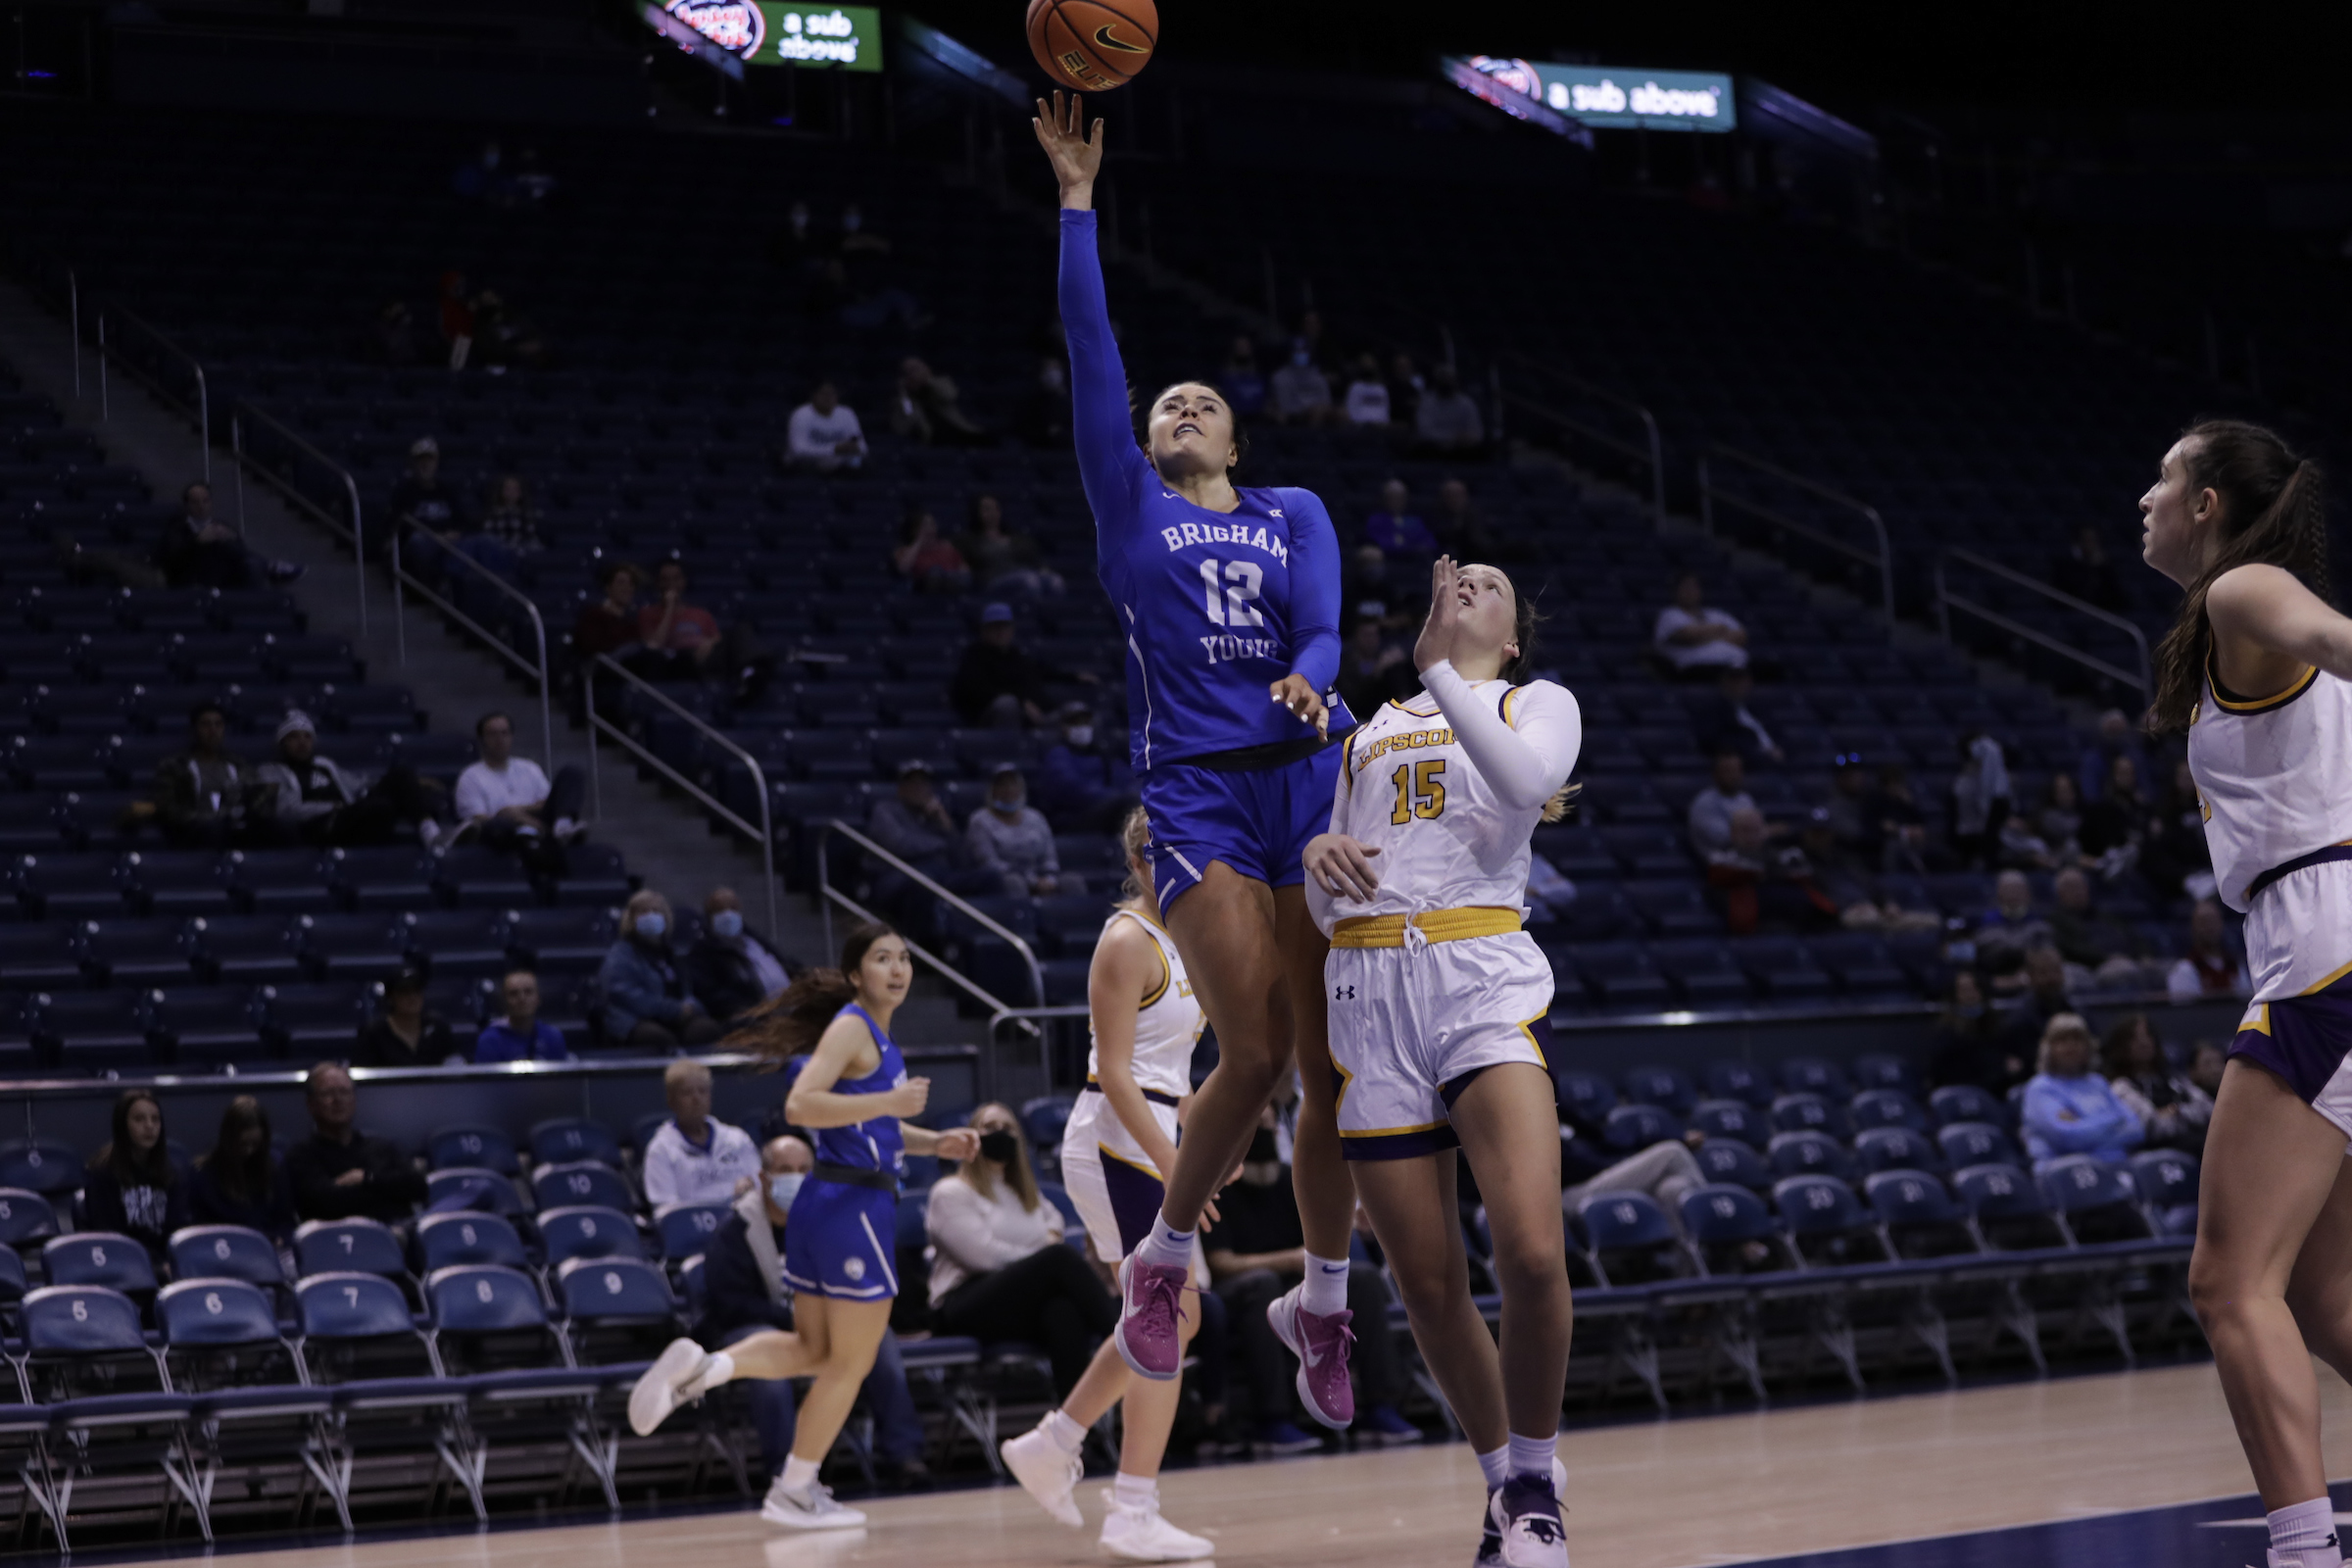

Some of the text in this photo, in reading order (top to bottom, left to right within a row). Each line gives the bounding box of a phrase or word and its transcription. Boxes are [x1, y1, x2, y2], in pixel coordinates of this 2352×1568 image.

[783, 10, 853, 37] a sub
[778, 33, 857, 63] above
[1547, 81, 1570, 110] a
[1571, 78, 1627, 113] sub
[1630, 80, 1718, 118] above
[1160, 522, 1289, 568] BRIGHAM
[1200, 558, 1264, 627] 12
[1200, 634, 1279, 664] YOUNG
[1391, 760, 1446, 825] 15
[337, 1234, 354, 1254] 7
[72, 1299, 87, 1322] 5
[205, 1292, 222, 1314] 6
[342, 1286, 358, 1309] 7
